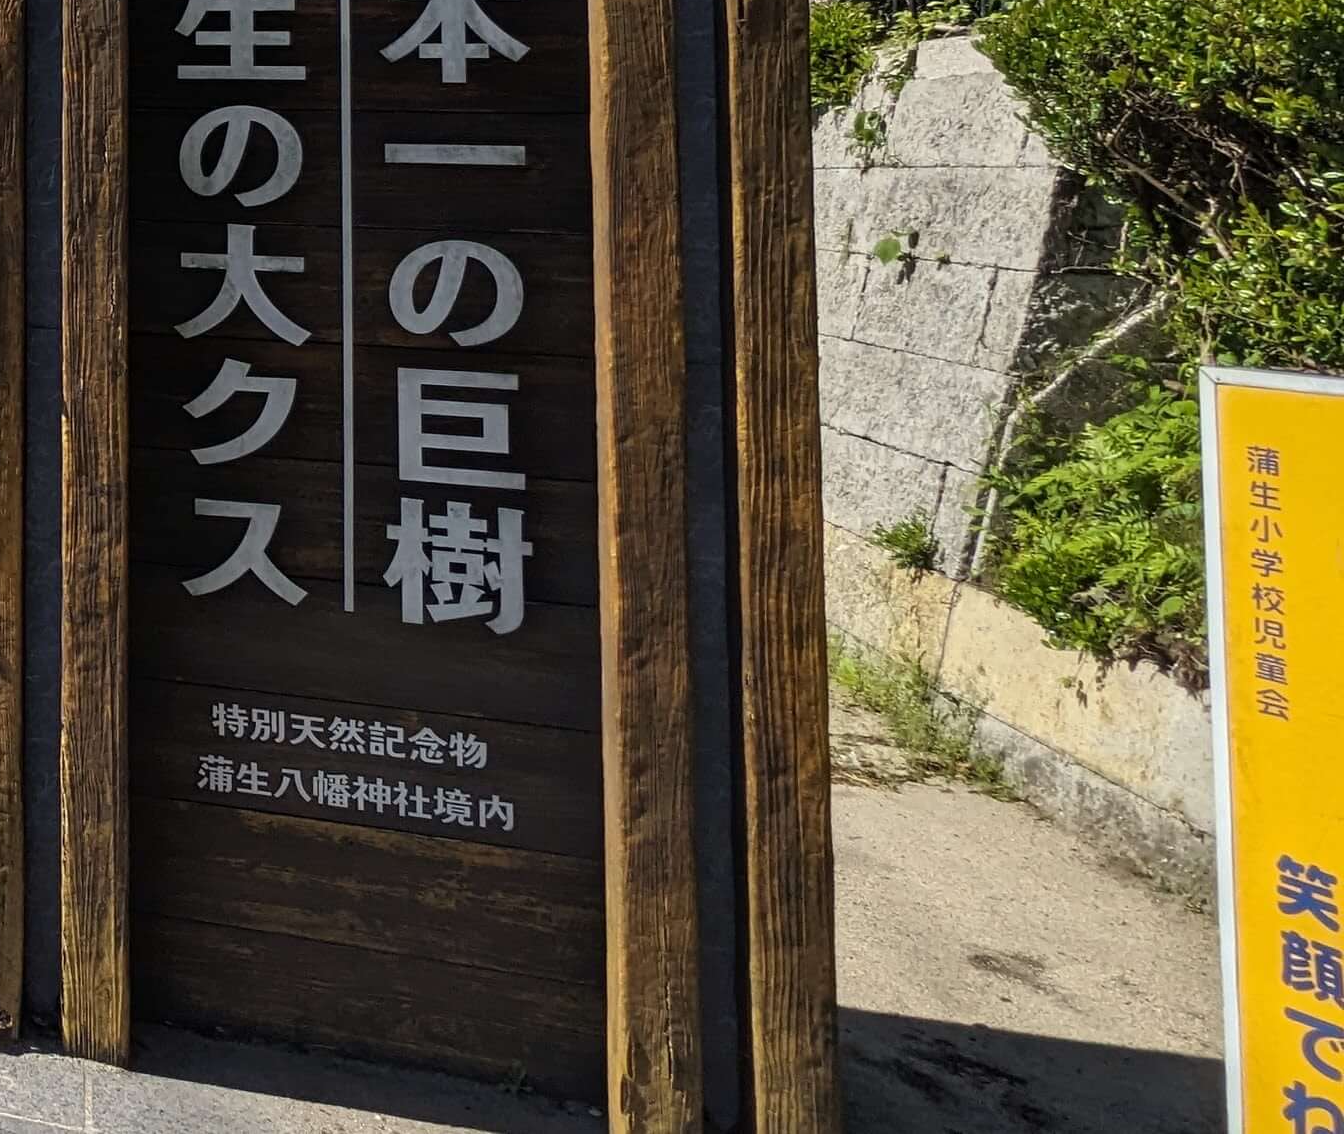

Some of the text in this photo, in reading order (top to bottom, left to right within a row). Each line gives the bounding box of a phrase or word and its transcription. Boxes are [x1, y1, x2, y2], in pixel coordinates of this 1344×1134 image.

[1246, 445, 1289, 723] 蒲生小学校児童会
[211, 702, 488, 770] 特別天然記念物
[196, 754, 515, 832] 蒲生八幡神社境内
